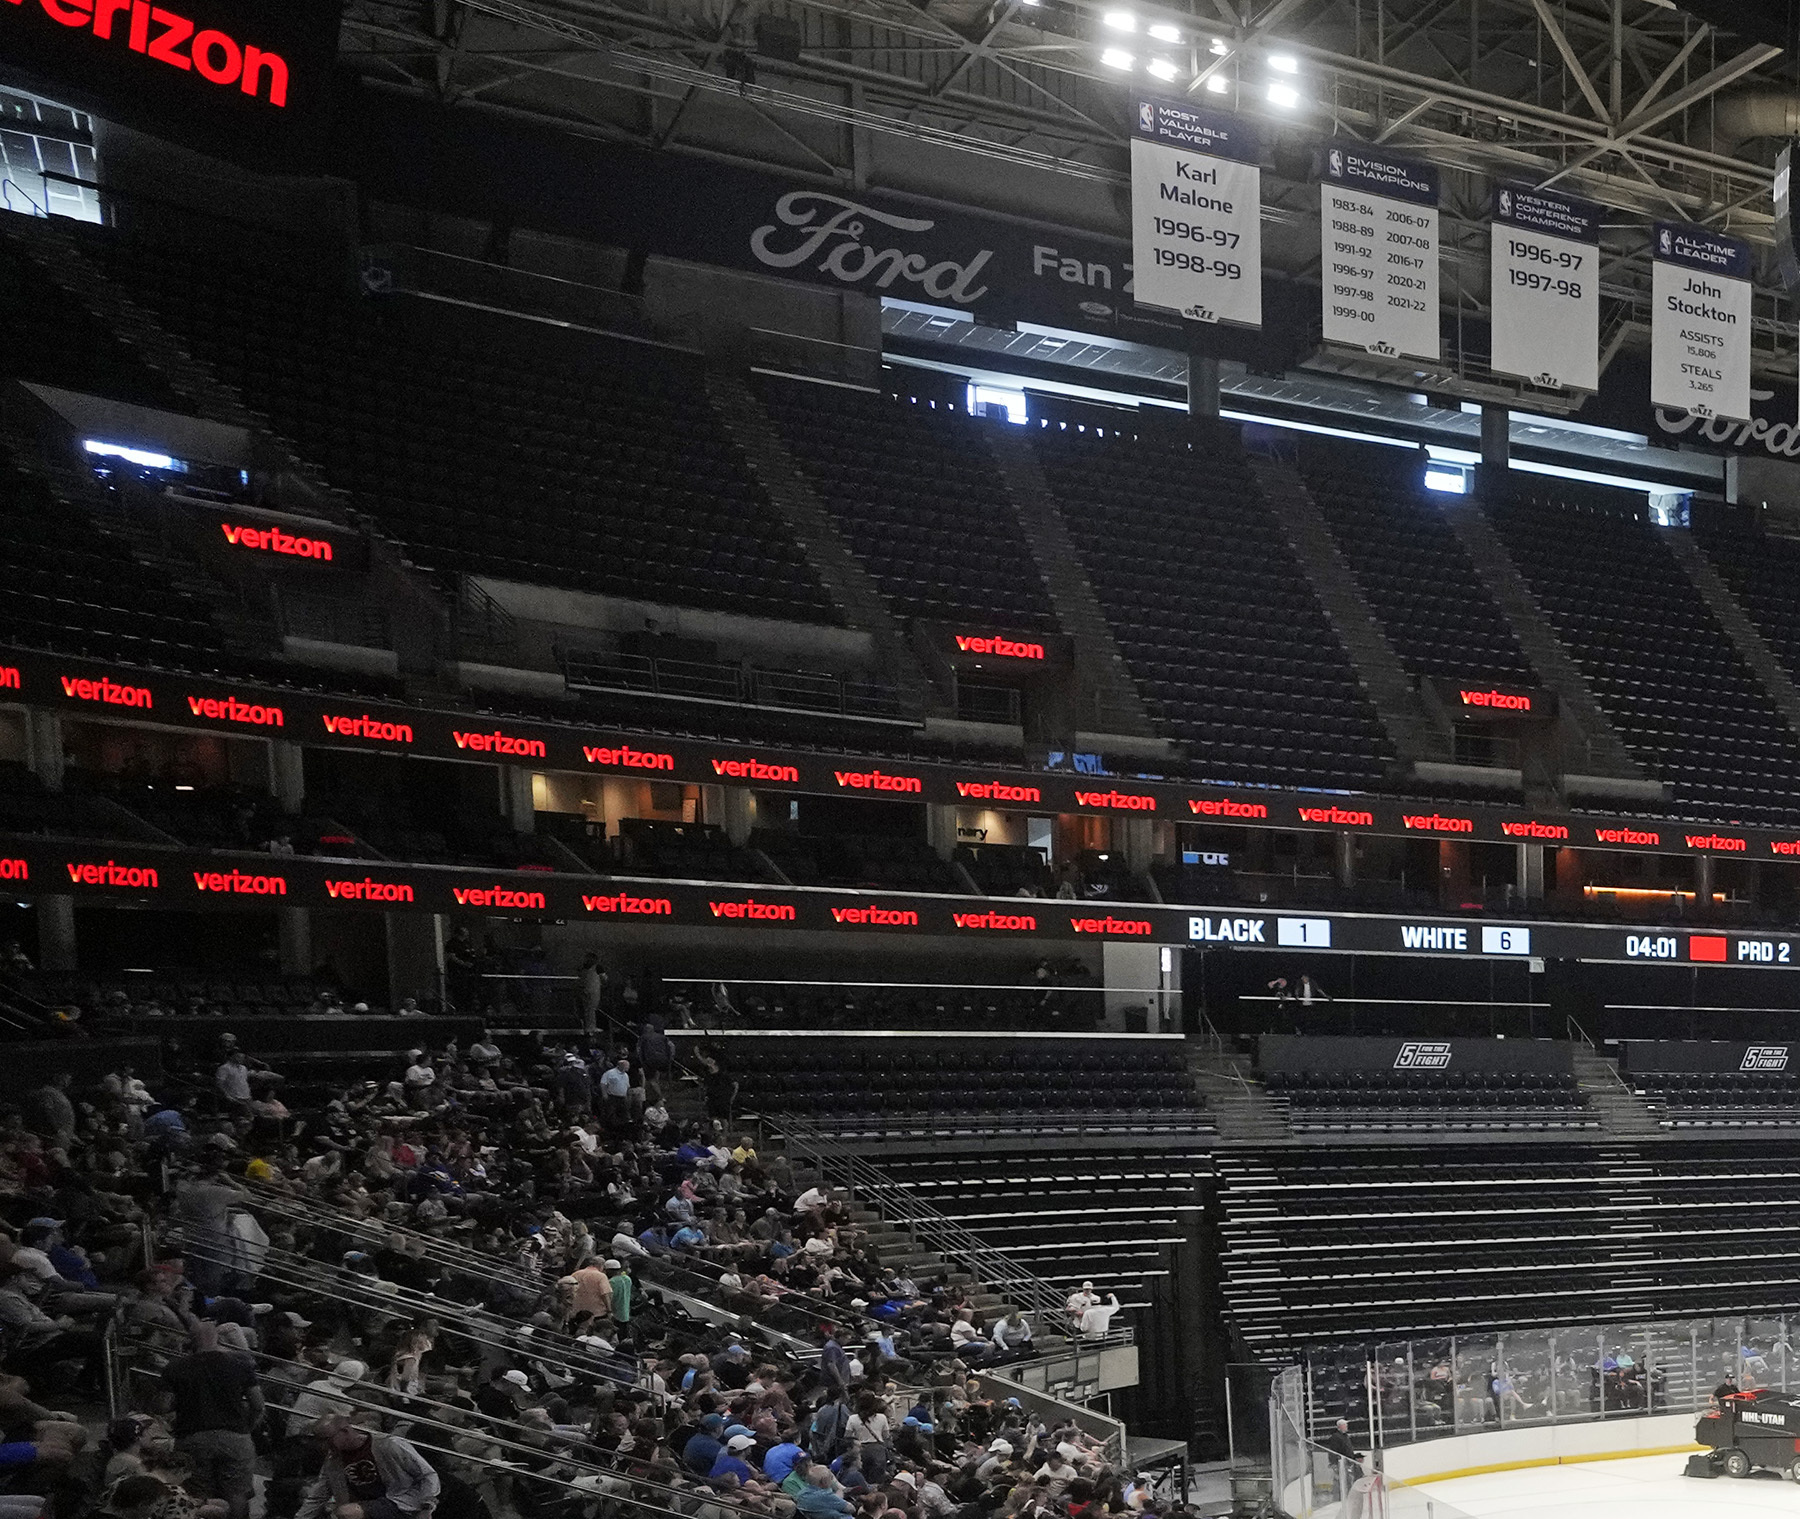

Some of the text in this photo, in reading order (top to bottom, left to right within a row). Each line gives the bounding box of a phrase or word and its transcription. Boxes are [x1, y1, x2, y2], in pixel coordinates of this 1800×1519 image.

[0, 0, 289, 107] erizon
[1159, 107, 1199, 122] MOST
[1159, 118, 1229, 140] VALUABLE
[1159, 128, 1211, 146] PLAYER
[1176, 161, 1217, 186] Karl
[1347, 156, 1407, 178] DIVISION
[1347, 166, 1430, 192] CHAMPIONS
[1160, 183, 1233, 214] Malone
[1332, 198, 1374, 216] 1983-84
[1516, 193, 1571, 213] WESTERN
[1386, 210, 1430, 229] 2006-07
[1516, 203, 1589, 227] CONFERENCE
[1516, 212, 1583, 234] CHAMPIONS
[1154, 216, 1240, 250] 1996-97
[1332, 219, 1374, 238] 1988-89
[750, 190, 994, 303] Ford
[1334, 242, 1373, 259] 1991-92
[1386, 232, 1430, 250] 2007-08
[1675, 236, 1736, 257] ALL-TIME
[1154, 248, 1241, 280] 1998-99
[1387, 253, 1424, 270] 2016-17
[1509, 240, 1583, 271] 1996-97
[1675, 246, 1728, 266] LEADER
[1033, 245, 1112, 290] Fan
[1333, 263, 1374, 281] 1996-97
[1333, 284, 1374, 302] 1997-98
[1387, 274, 1427, 291] 2020-21
[1509, 269, 1582, 299] 1997-98
[1683, 278, 1722, 300] John
[1333, 305, 1375, 323] 1999-00
[1387, 296, 1427, 313] 2021-22
[1667, 297, 1737, 325] Stockton
[1679, 329, 1725, 347] ASSISTS
[1680, 363, 1723, 380] STEALS
[221, 523, 333, 561] verizon
[955, 636, 1044, 659] verizon
[61, 676, 922, 792] verizon verizon verizon verizon
[1298, 806, 1569, 839] verizon verizon
[67, 860, 796, 920] verizon verizon verizon
[1189, 917, 1308, 943] BLACK 1
[1401, 926, 1511, 951] WHITE 6
[1626, 935, 1677, 958] 04:01
[1737, 940, 1790, 962] PRD 2
[1415, 1055, 1447, 1066] FIGHT
[1759, 1058, 1786, 1068] FIGHT
